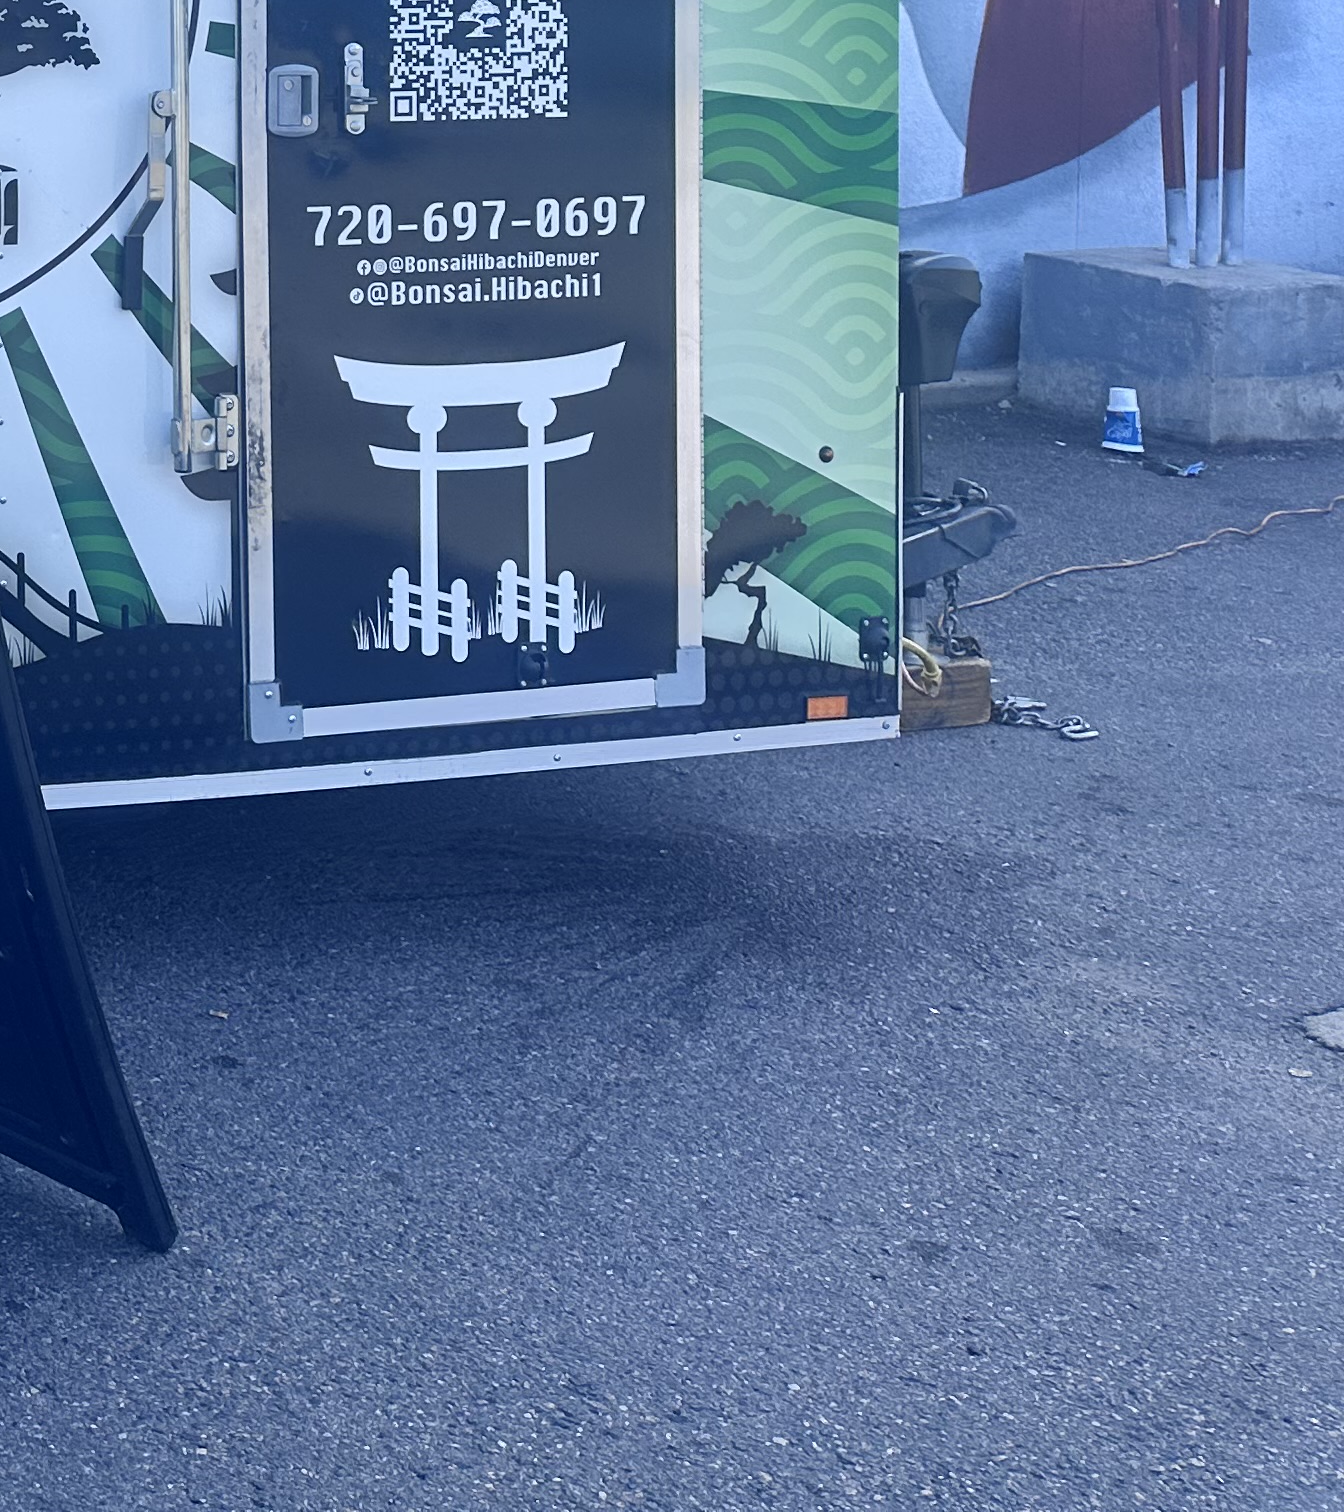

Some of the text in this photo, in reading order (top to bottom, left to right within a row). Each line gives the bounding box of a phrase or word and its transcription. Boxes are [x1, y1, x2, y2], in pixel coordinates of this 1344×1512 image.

[306, 194, 646, 246] 720-697-0697
[388, 250, 599, 275] @BonsaiHibachiDenver
[367, 272, 602, 306] @Bonsai.Hibachi1
